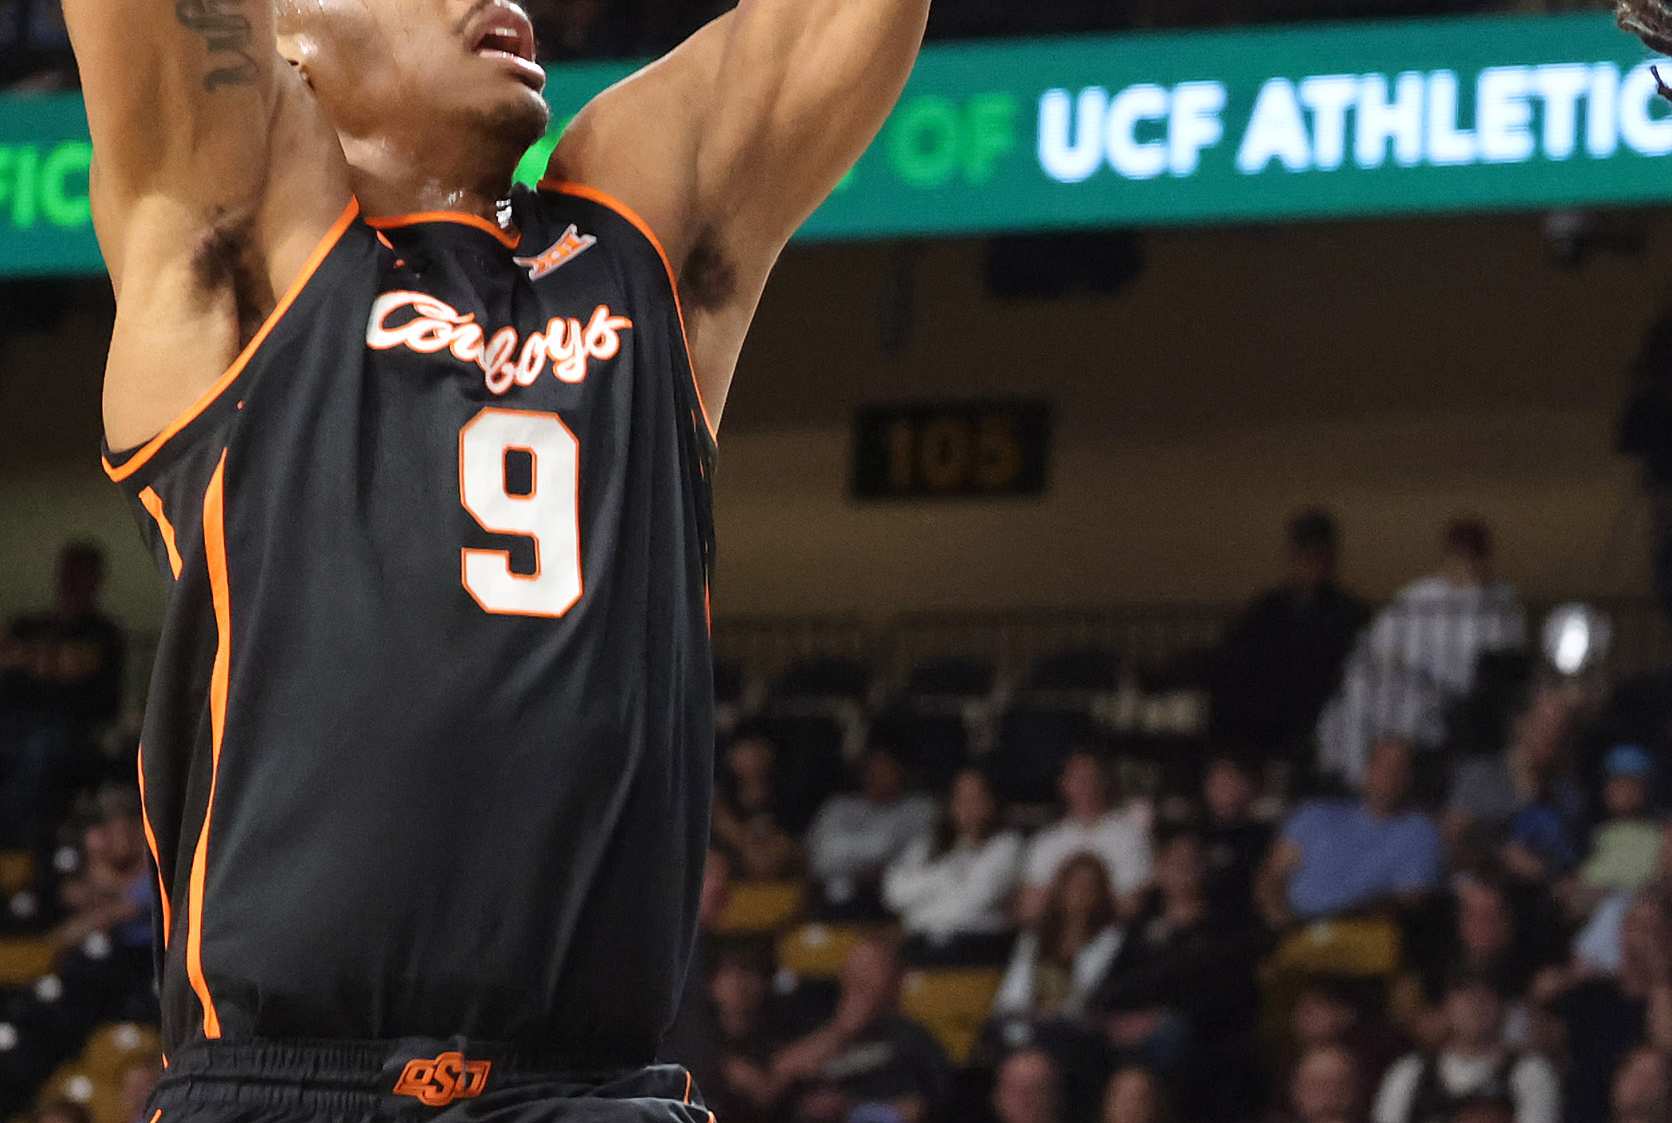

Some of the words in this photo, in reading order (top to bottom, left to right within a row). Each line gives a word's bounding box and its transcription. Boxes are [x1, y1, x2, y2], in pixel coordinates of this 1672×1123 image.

[889, 92, 1018, 188] OF
[1036, 80, 1227, 184] UCF
[366, 290, 633, 395] Cowboys
[886, 412, 1025, 490] 105
[459, 406, 584, 618] 9
